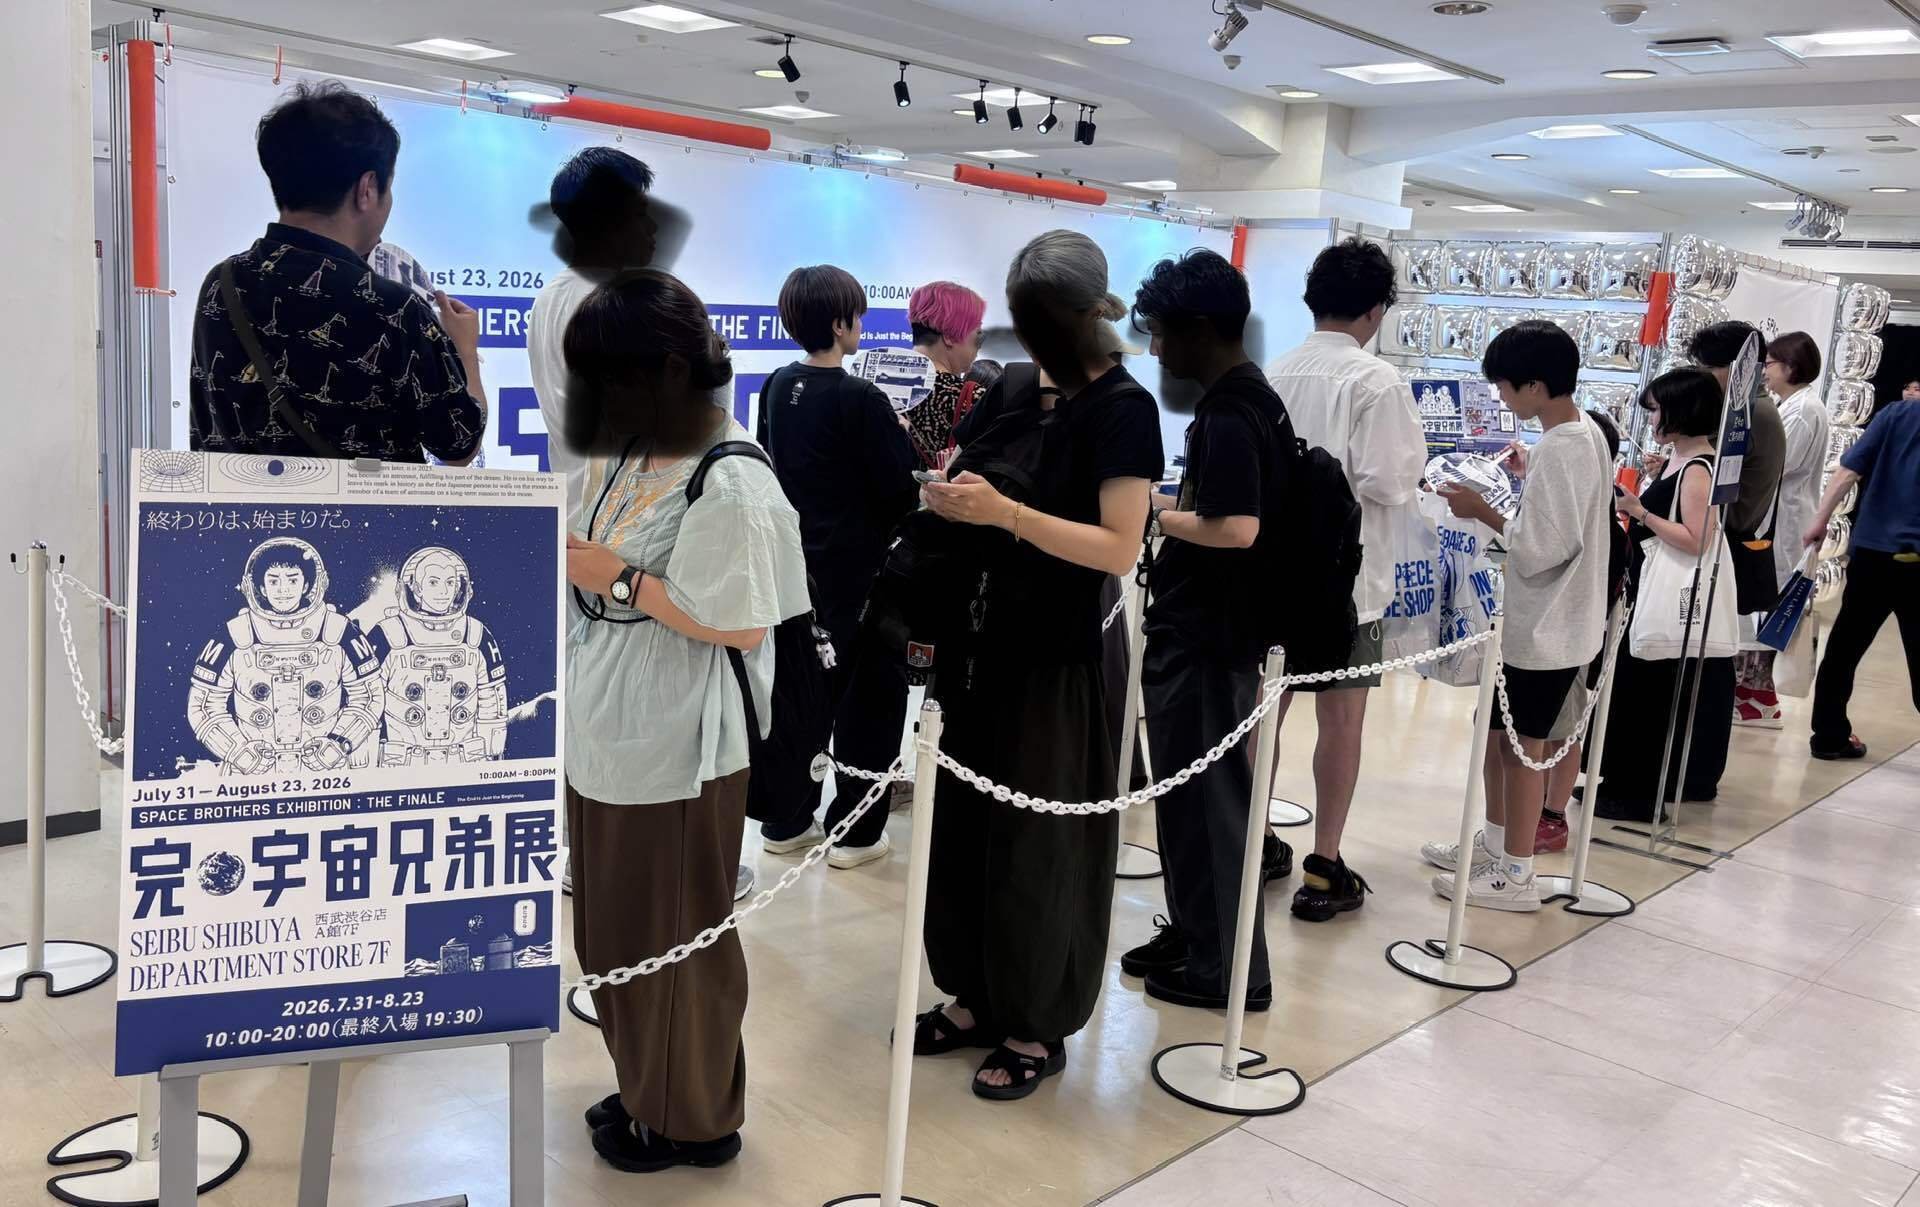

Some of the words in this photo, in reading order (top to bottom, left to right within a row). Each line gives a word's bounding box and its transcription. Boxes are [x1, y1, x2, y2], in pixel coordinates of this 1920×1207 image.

[462, 268, 491, 288] 23,
[498, 270, 544, 289] 2026
[709, 315, 749, 340] THE
[758, 316, 794, 340] FIN
[901, 334, 913, 342] Beg
[146, 509, 351, 531] 終わりは、始まりだ。
[1404, 588, 1434, 618] SHOP
[200, 640, 224, 665] M
[351, 634, 376, 660] M
[132, 788, 171, 803] July
[176, 786, 194, 800] 31
[216, 782, 276, 798] August
[282, 780, 306, 792] 23,
[312, 776, 351, 790] 2026
[139, 808, 188, 824] SPACE
[194, 804, 270, 820] BROTHERS
[276, 798, 351, 814] EXHIBITION
[367, 796, 392, 809] THE
[398, 792, 445, 806] FINALE
[129, 836, 192, 920] 完
[251, 809, 558, 908] 宇宙兄弟展
[315, 908, 388, 926] 西武渋谷店
[130, 926, 198, 958] SEIBU
[202, 916, 302, 950] SHIBUYA
[314, 922, 360, 939] A館7F
[129, 950, 288, 992] DEPARTMENT
[293, 942, 364, 974] STORE
[368, 940, 392, 966] 7F
[282, 990, 424, 1016] 2026.7.31-8.23
